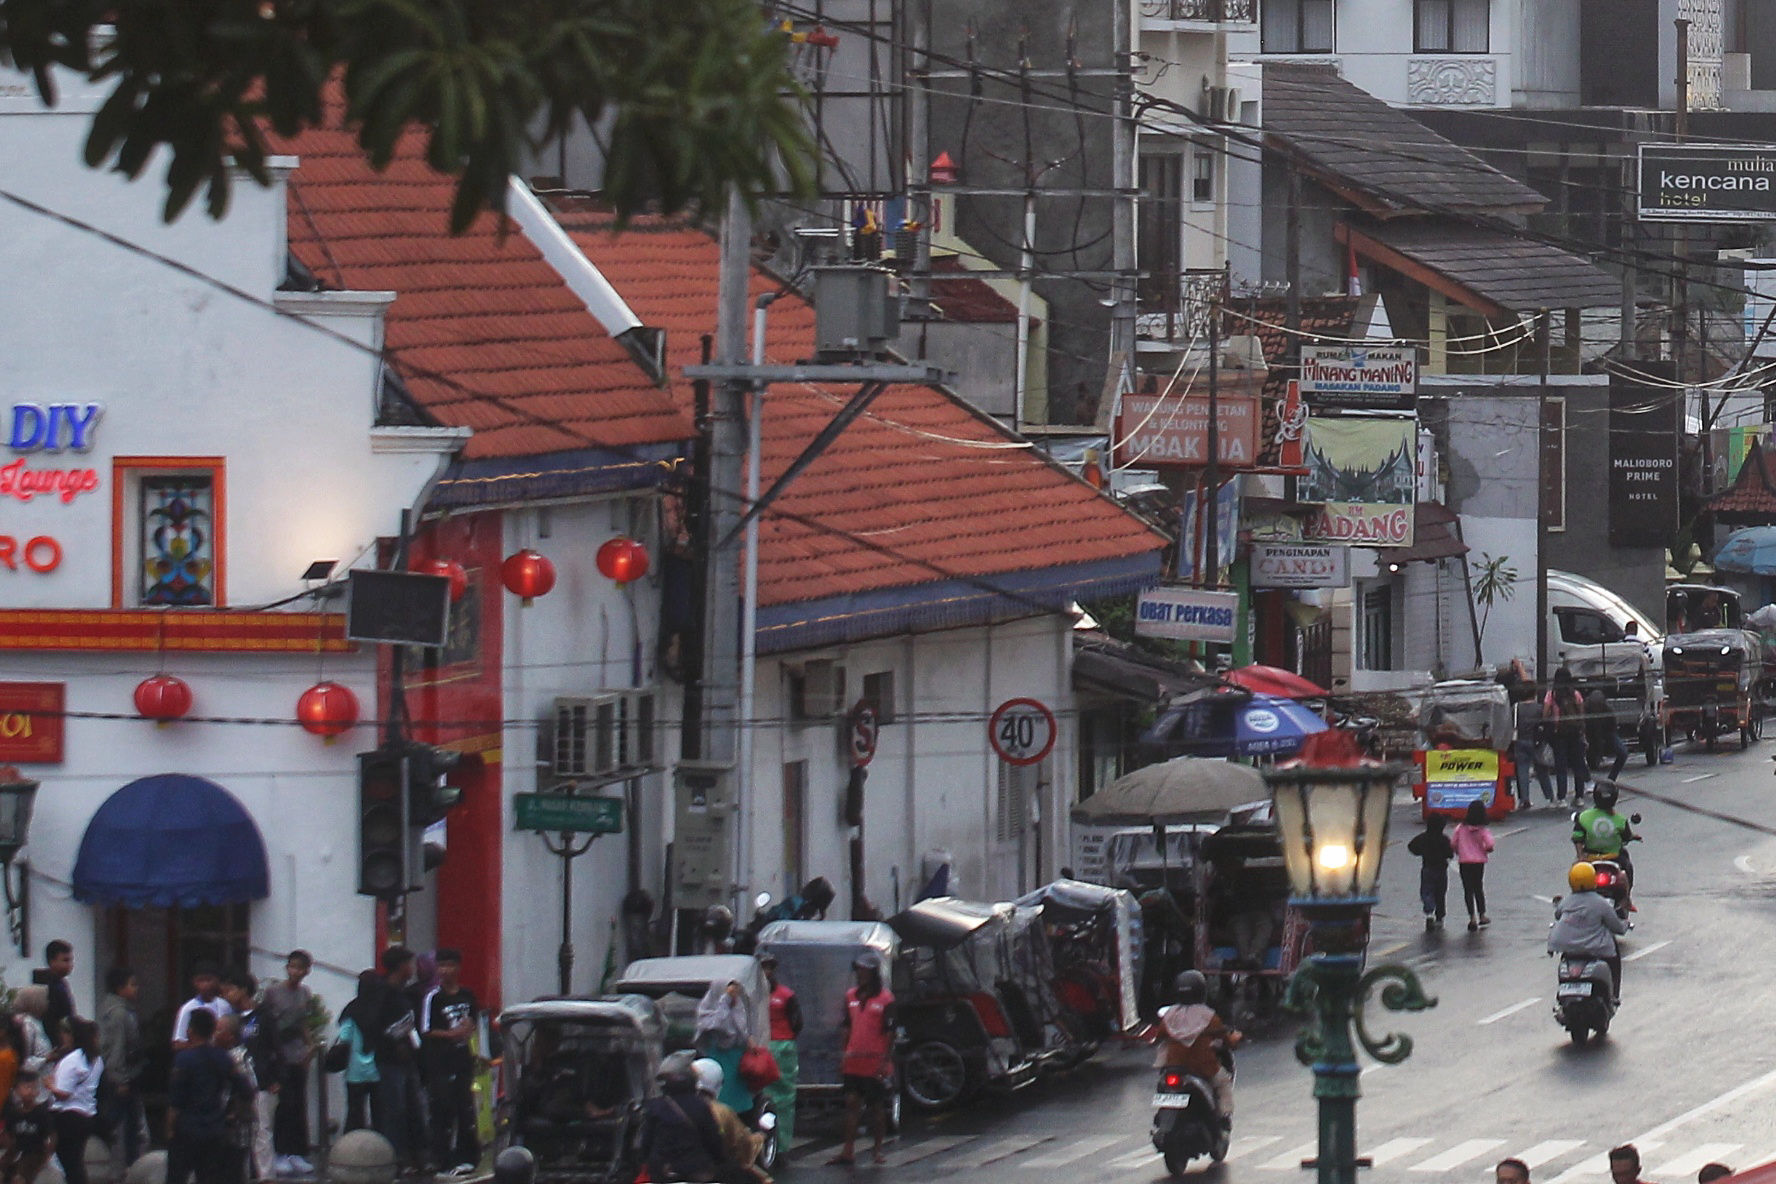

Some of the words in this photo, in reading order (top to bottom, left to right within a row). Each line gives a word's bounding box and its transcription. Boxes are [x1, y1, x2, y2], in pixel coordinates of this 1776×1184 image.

[1727, 155, 1775, 172] mulia
[1660, 170, 1770, 191] kencana
[1303, 357, 1357, 382] MINANG
[1360, 360, 1413, 384] MANING
[1363, 383, 1402, 392] PADANG
[1186, 403, 1248, 417] PENETAN
[11, 404, 101, 451] DIY
[1128, 436, 1201, 459] MBAK
[1614, 459, 1673, 468] MALIOBORO
[1626, 471, 1661, 481] PRIME
[1301, 508, 1408, 542] PADANG
[1266, 547, 1331, 558] PENGINAPAN
[1001, 715, 1033, 748] 40
[1440, 761, 1484, 772] POWER
